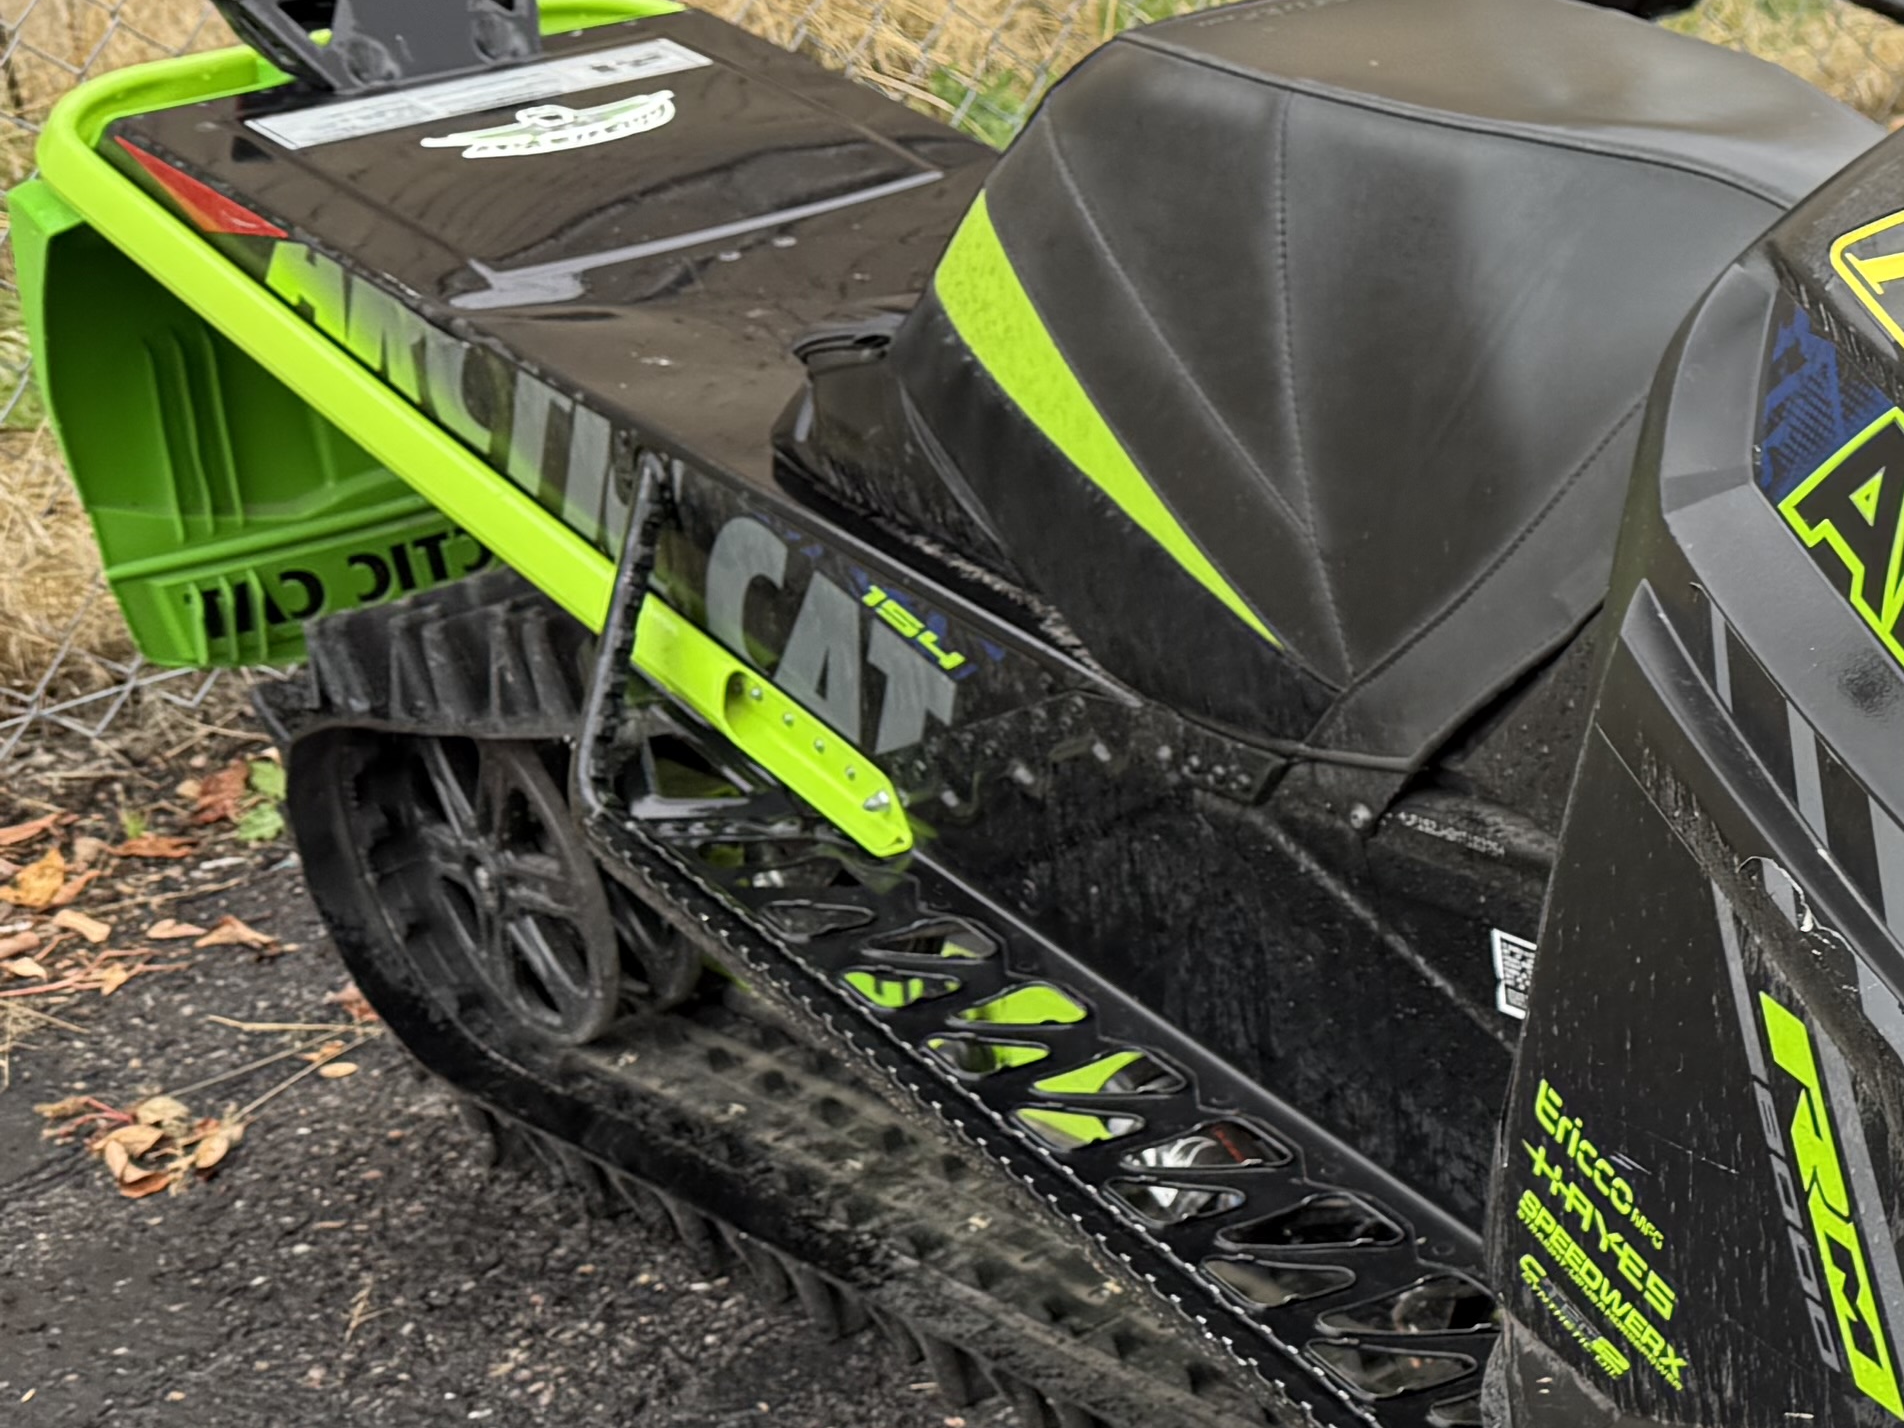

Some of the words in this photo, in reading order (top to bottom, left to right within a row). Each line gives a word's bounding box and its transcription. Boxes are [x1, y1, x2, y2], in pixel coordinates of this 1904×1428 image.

[705, 516, 957, 755] CAT
[861, 584, 966, 670] 154
[1521, 1138, 1677, 1321] HAYES
[1535, 1078, 1635, 1206] Ericco
[1753, 1080, 1841, 1373] 8000
[1517, 1189, 1689, 1380] SPEEDWERX
